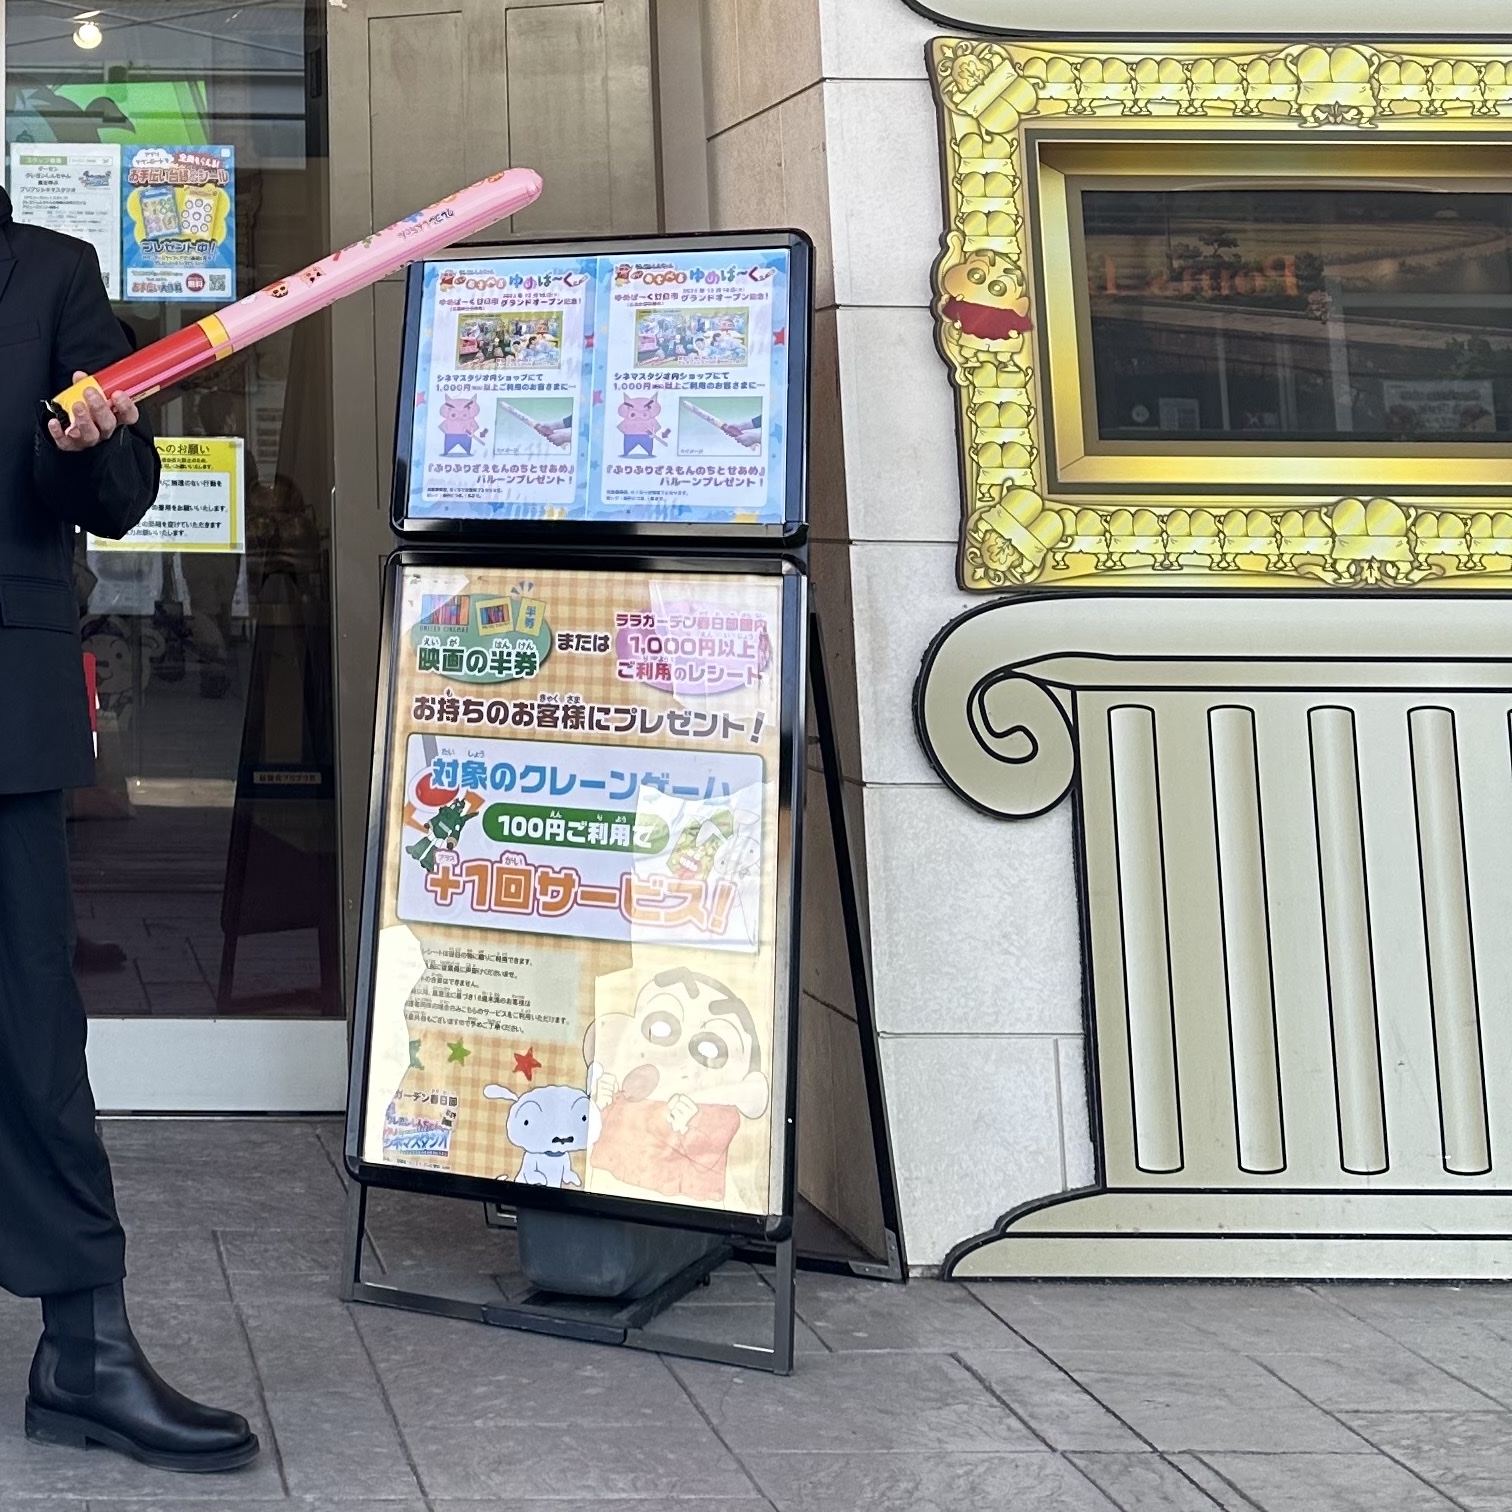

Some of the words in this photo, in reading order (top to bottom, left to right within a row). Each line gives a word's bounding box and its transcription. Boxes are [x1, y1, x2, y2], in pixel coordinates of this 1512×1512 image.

[417, 647, 539, 677] 映画の半券
[556, 631, 611, 654] または
[628, 634, 757, 660] 1,000円以上
[616, 660, 765, 686] ご利用のレシート
[412, 694, 767, 744] お持ちのお客様にプレゼント！
[497, 815, 657, 850] 100円ご利用で
[427, 859, 735, 933] +1回サービス！
